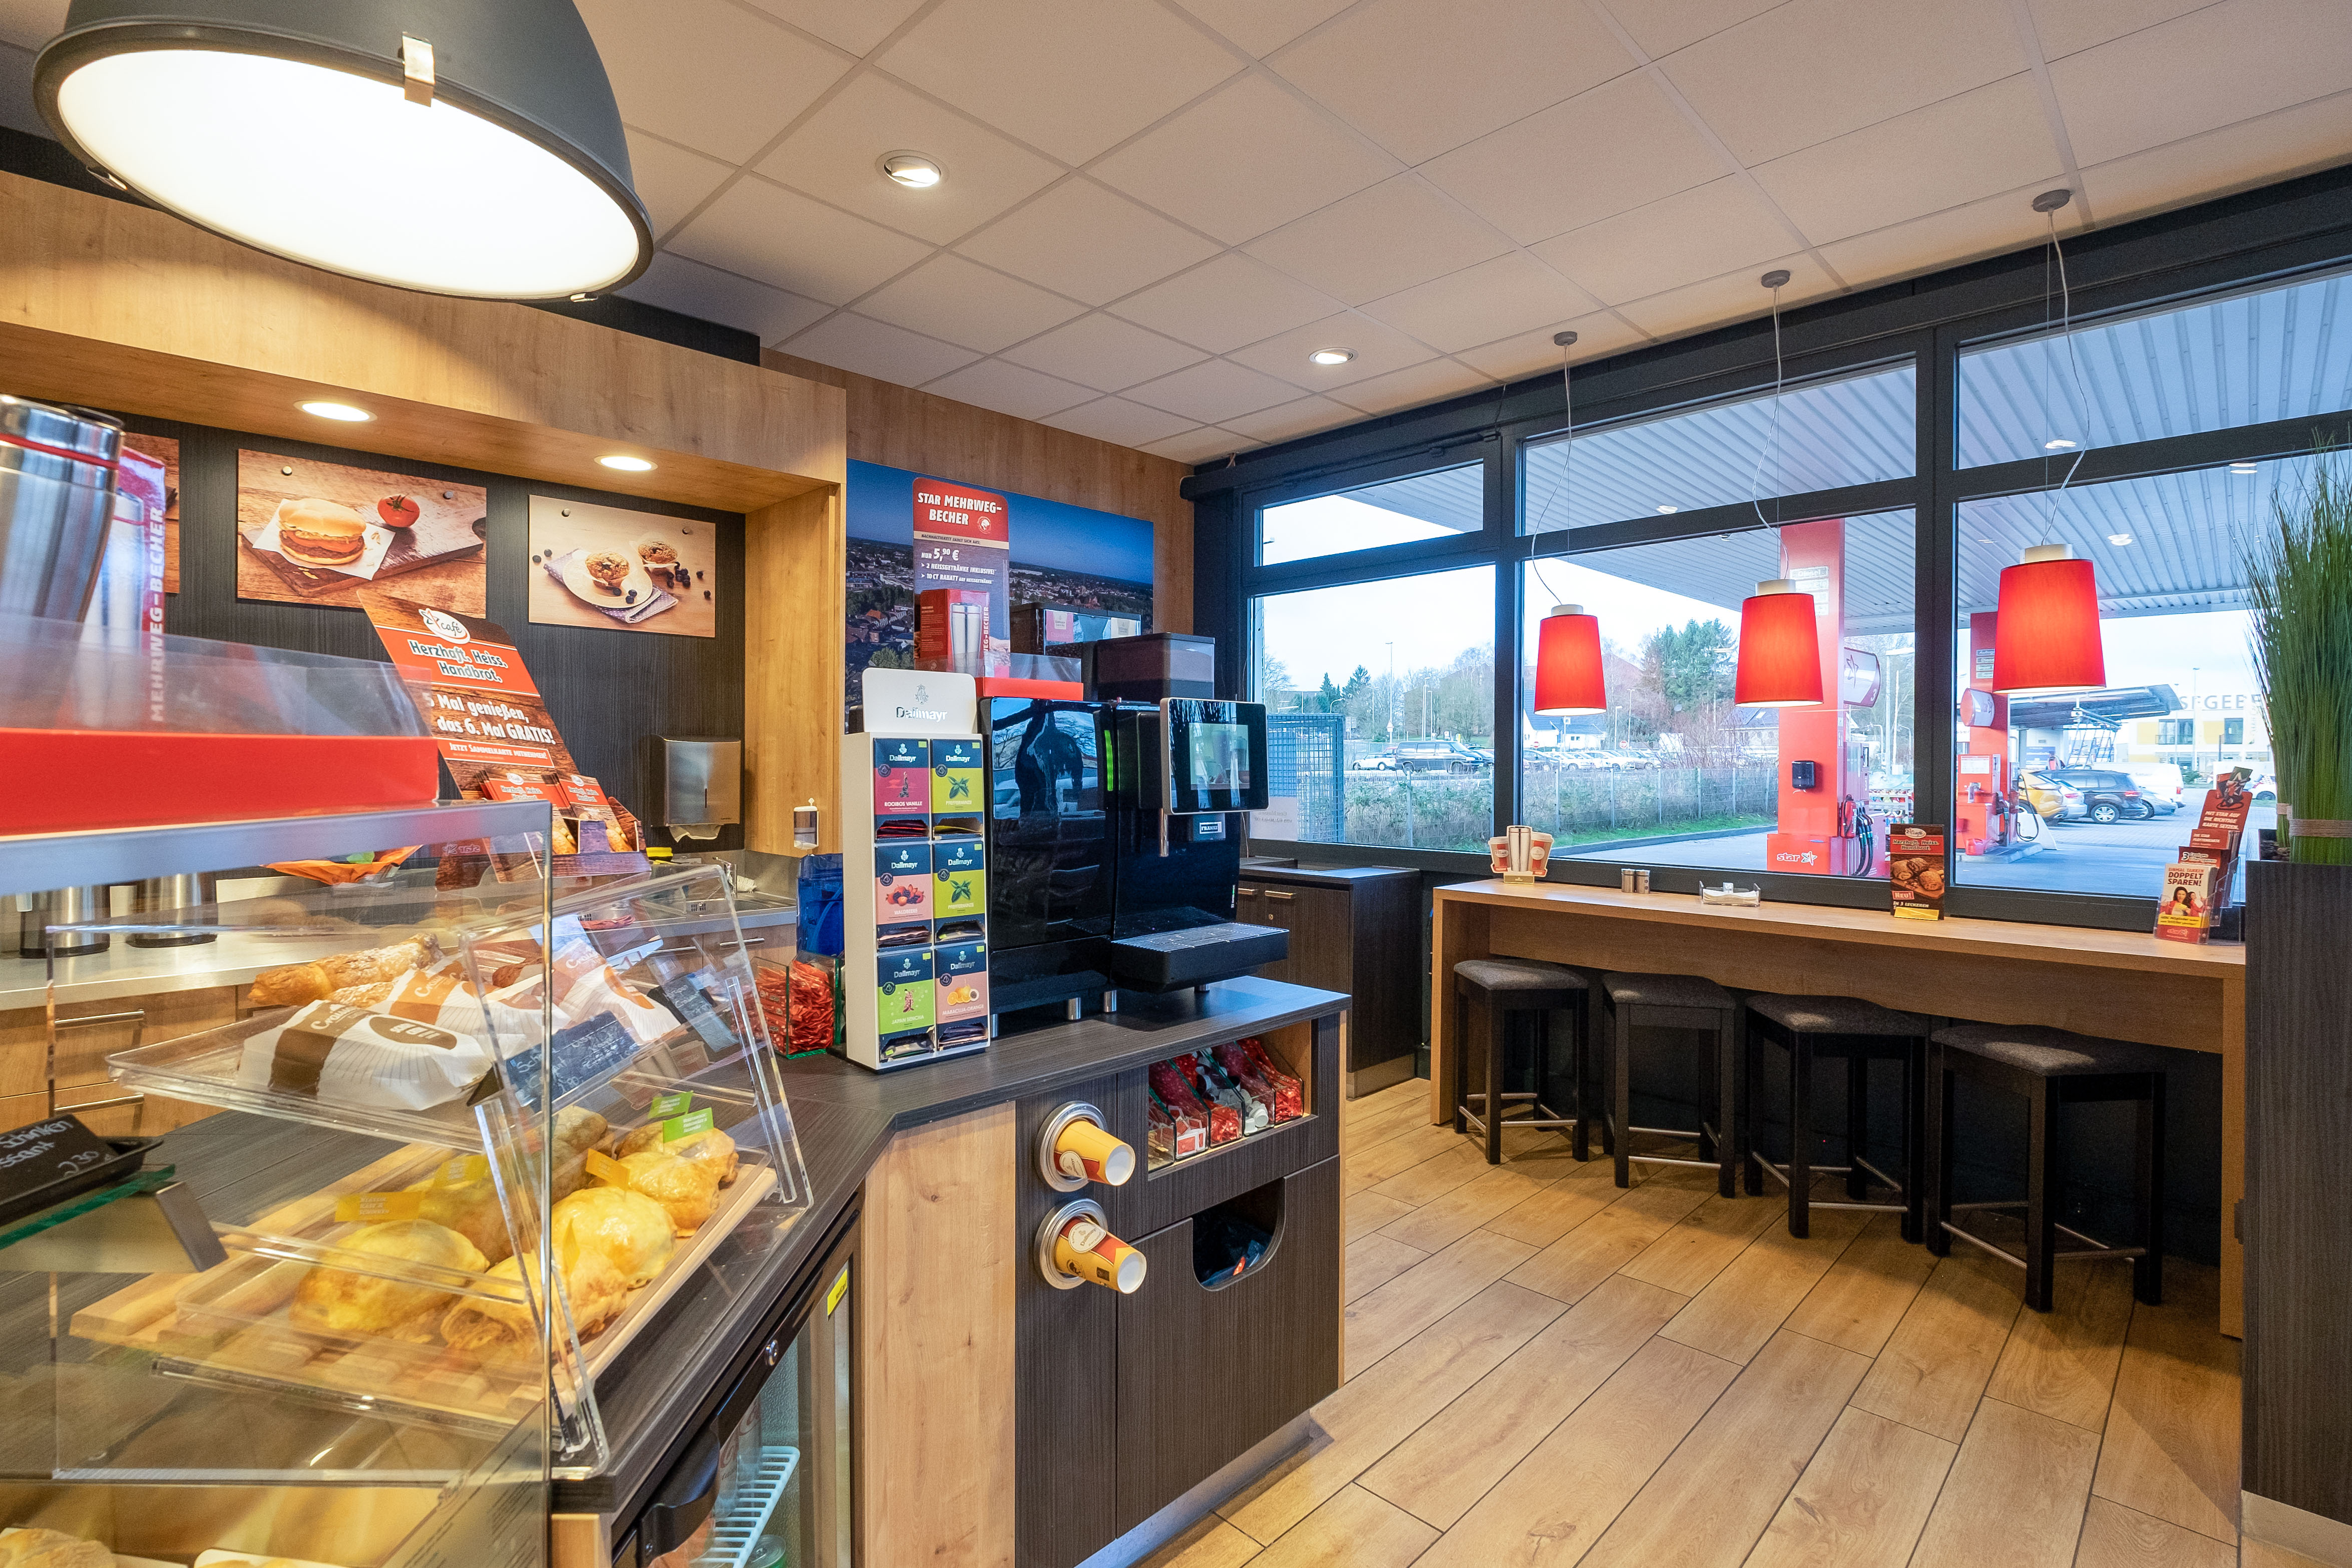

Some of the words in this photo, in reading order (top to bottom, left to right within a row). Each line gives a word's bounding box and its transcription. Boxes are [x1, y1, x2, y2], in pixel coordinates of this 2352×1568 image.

[918, 493, 941, 505] STAR
[944, 495, 1002, 514] MEHRWEG-
[929, 509, 969, 525] BECHER
[150, 507, 164, 722] MEHRWEG-BECHER
[441, 622, 462, 636] café
[409, 640, 472, 663] Herzhaft.
[473, 649, 508, 668] Heiss.
[439, 661, 502, 682] Handbrot.
[1871, 688, 1877, 701] 3
[437, 694, 465, 711] Mal
[468, 701, 530, 723] genießen,
[896, 706, 948, 722] Dallmayr
[437, 716, 464, 732] das
[465, 718, 481, 735] 6.
[481, 721, 506, 737] Mal
[506, 722, 556, 744] GRATIS!
[889, 754, 916, 762] Dallmayr
[946, 755, 970, 763] Dallmayr
[1777, 853, 1800, 862] star
[2181, 852, 2189, 860] 3
[2167, 878, 2201, 886] SPAREN!
[951, 961, 975, 970] Dallmayr
[894, 970, 921, 978] Dallmayr
